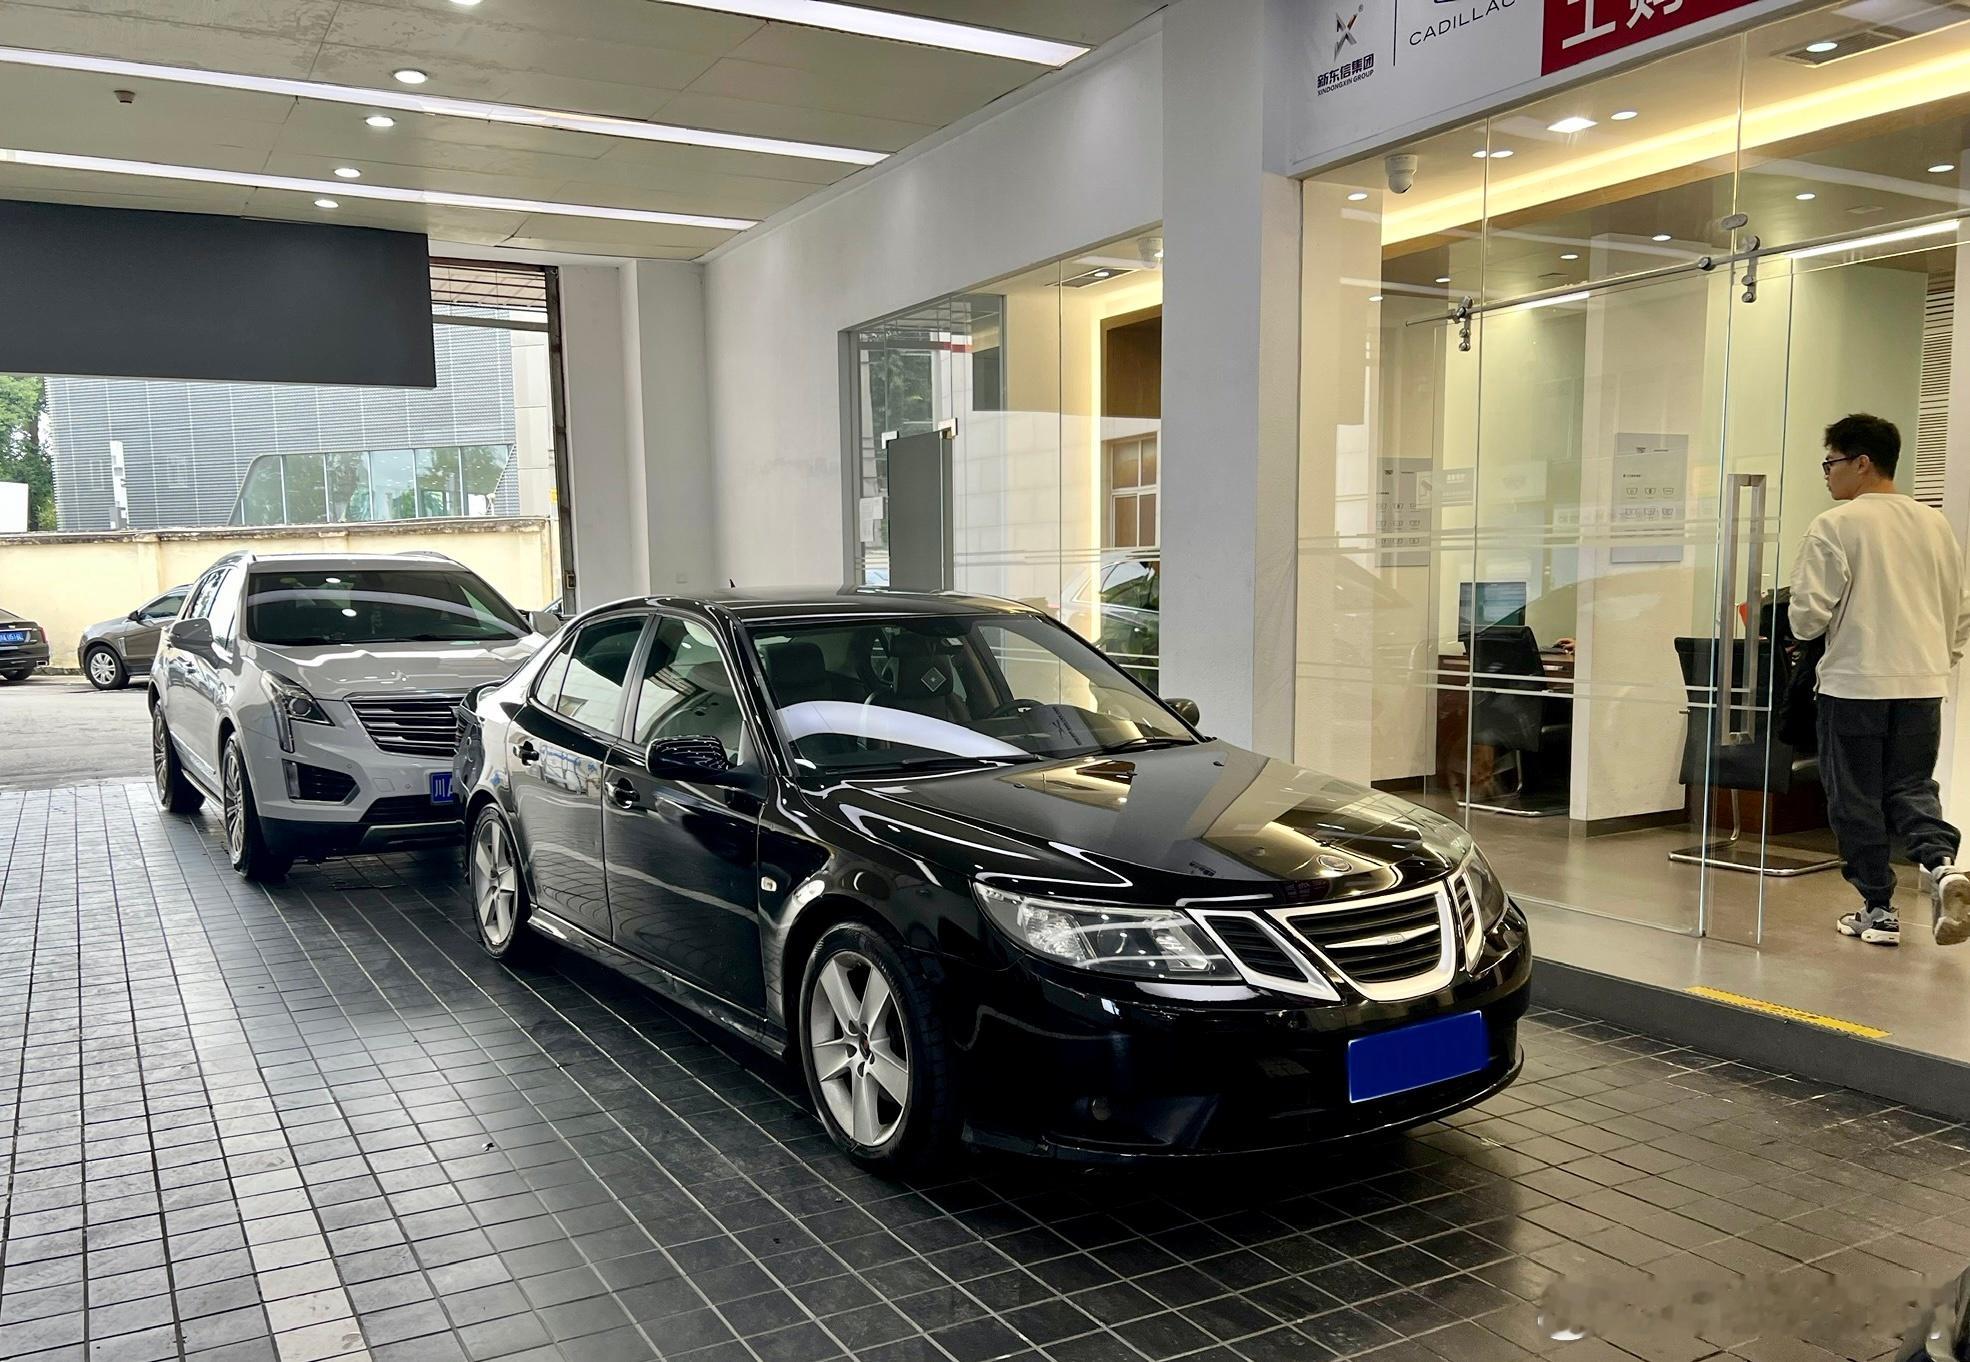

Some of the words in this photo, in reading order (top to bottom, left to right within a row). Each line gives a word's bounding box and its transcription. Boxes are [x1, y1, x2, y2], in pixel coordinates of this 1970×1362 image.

[1317, 53, 1375, 88] 新东信集团
[1317, 77, 1353, 96] XINDONGXIN
[1353, 69, 1374, 83] GROUP
